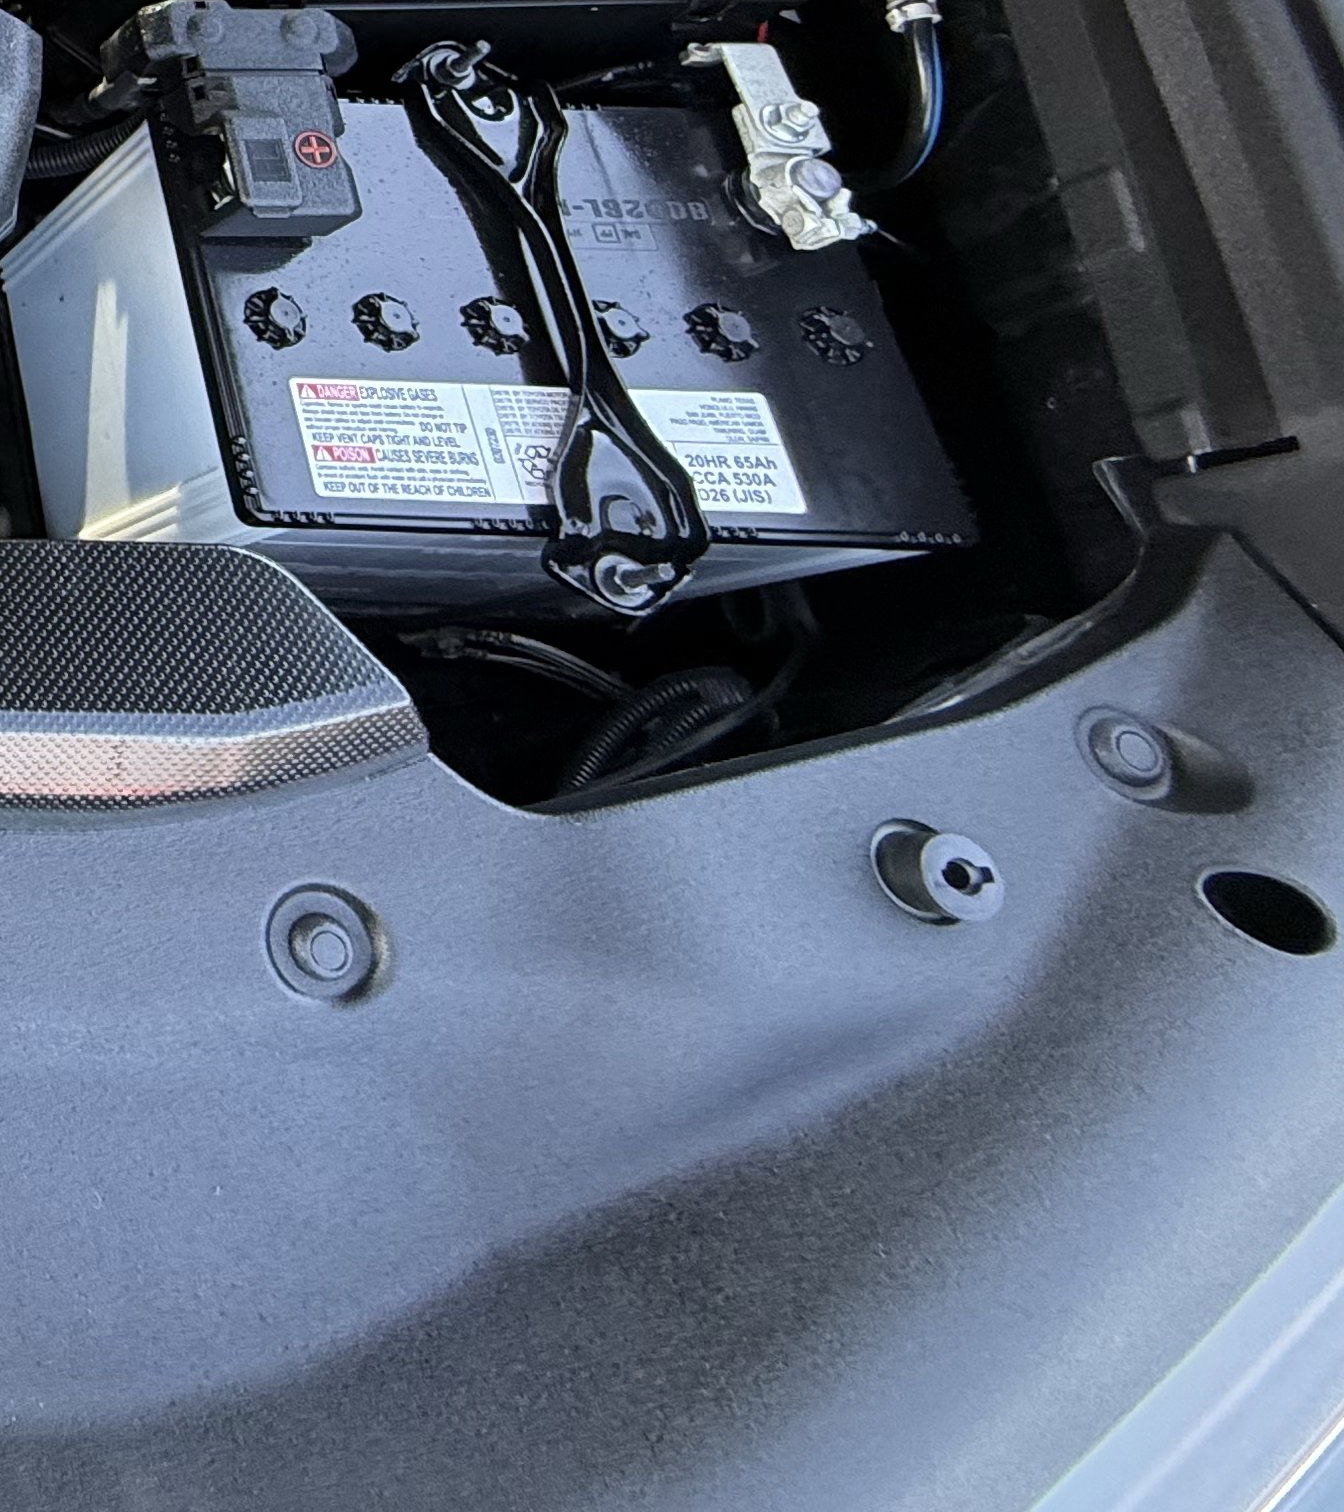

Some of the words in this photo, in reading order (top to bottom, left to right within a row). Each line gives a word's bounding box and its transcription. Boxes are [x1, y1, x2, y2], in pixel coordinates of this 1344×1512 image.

[316, 385, 357, 399] DANGER
[359, 386, 407, 401] EXPLOSIVE
[408, 388, 438, 402] GASES
[419, 421, 433, 433] DO
[434, 422, 452, 433] NOT
[453, 423, 468, 433] TIP
[312, 432, 334, 443] KEEP
[336, 433, 358, 444] VENT
[360, 434, 384, 446] CAPS
[385, 434, 410, 446] TIGHT
[413, 436, 431, 447] AND
[432, 437, 461, 448] LEVEL
[333, 447, 370, 461] POISON
[375, 449, 411, 463] CAUSES
[412, 450, 448, 465] SEVERE
[449, 451, 480, 466] BURNS
[684, 454, 731, 469] 20HR
[734, 455, 778, 470] 65Ah
[693, 471, 731, 486] CCA
[733, 472, 777, 487] 530A
[323, 482, 346, 492] KEEP
[348, 482, 366, 493] OUT
[368, 483, 379, 493] OF
[381, 483, 399, 494] THE
[401, 484, 431, 495] REACH
[433, 485, 444, 496] OF
[446, 485, 491, 497] CHILDREN
[733, 489, 773, 504] (JIS)
